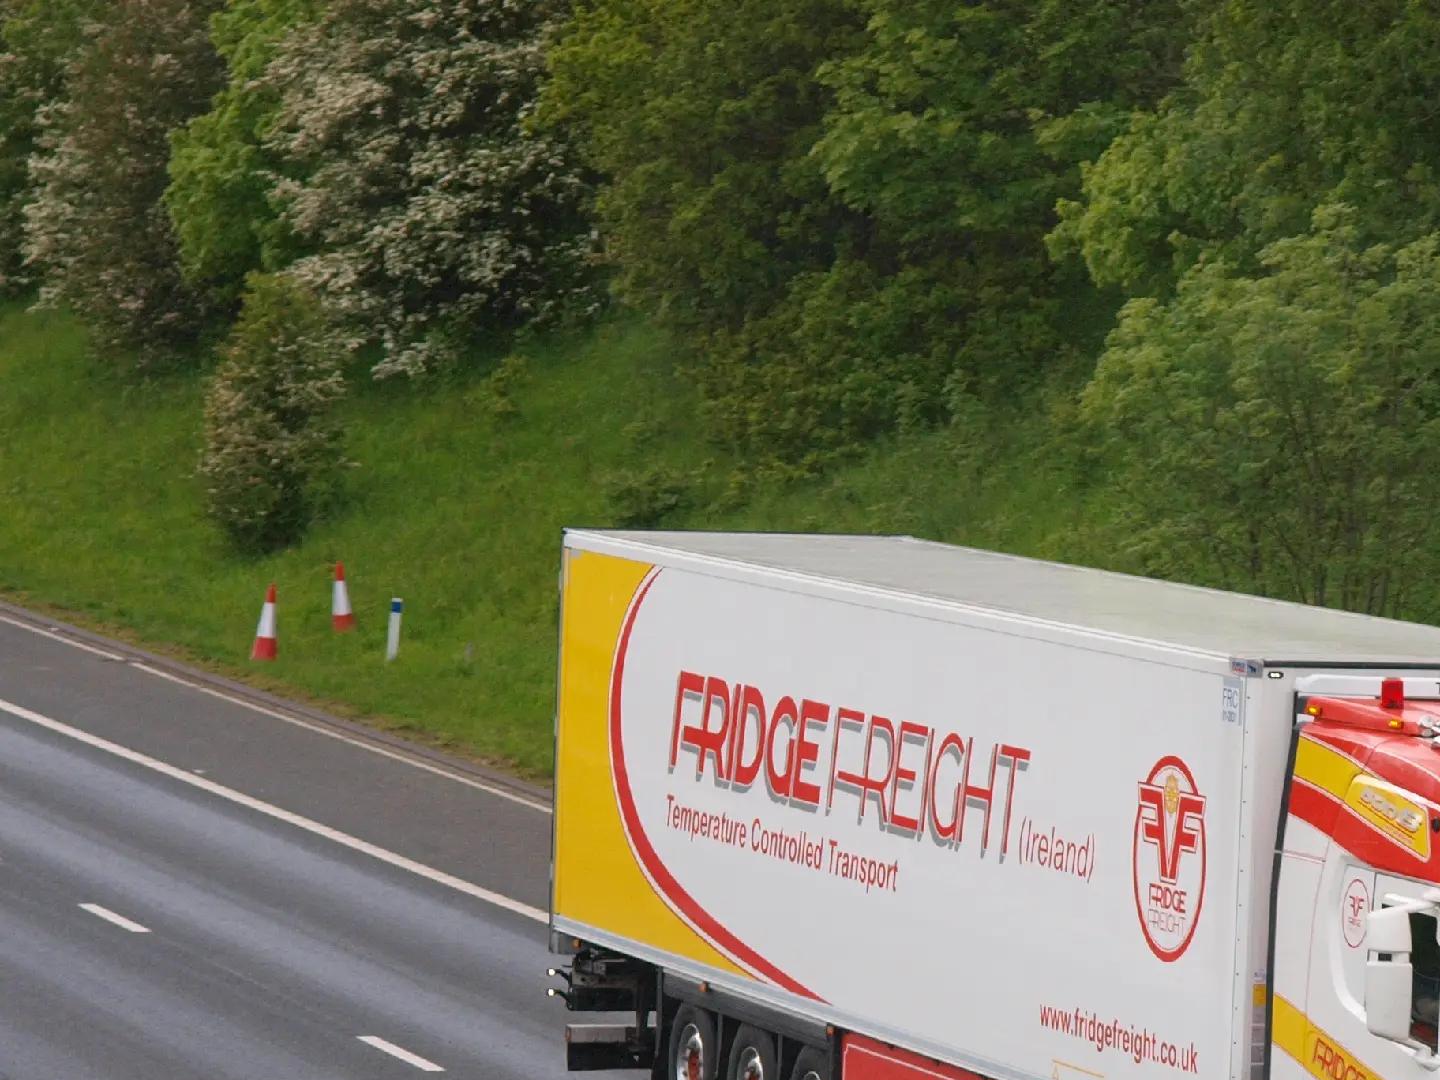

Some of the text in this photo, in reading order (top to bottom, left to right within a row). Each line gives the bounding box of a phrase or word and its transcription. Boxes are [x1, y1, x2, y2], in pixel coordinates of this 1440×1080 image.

[667, 794, 898, 894] Temperature Controlled Transport
[1019, 816, 1096, 884] (Ireland)
[1148, 883, 1187, 914] FRIDGE
[1039, 1003, 1199, 1075] www.fridgefreight.co.uk
